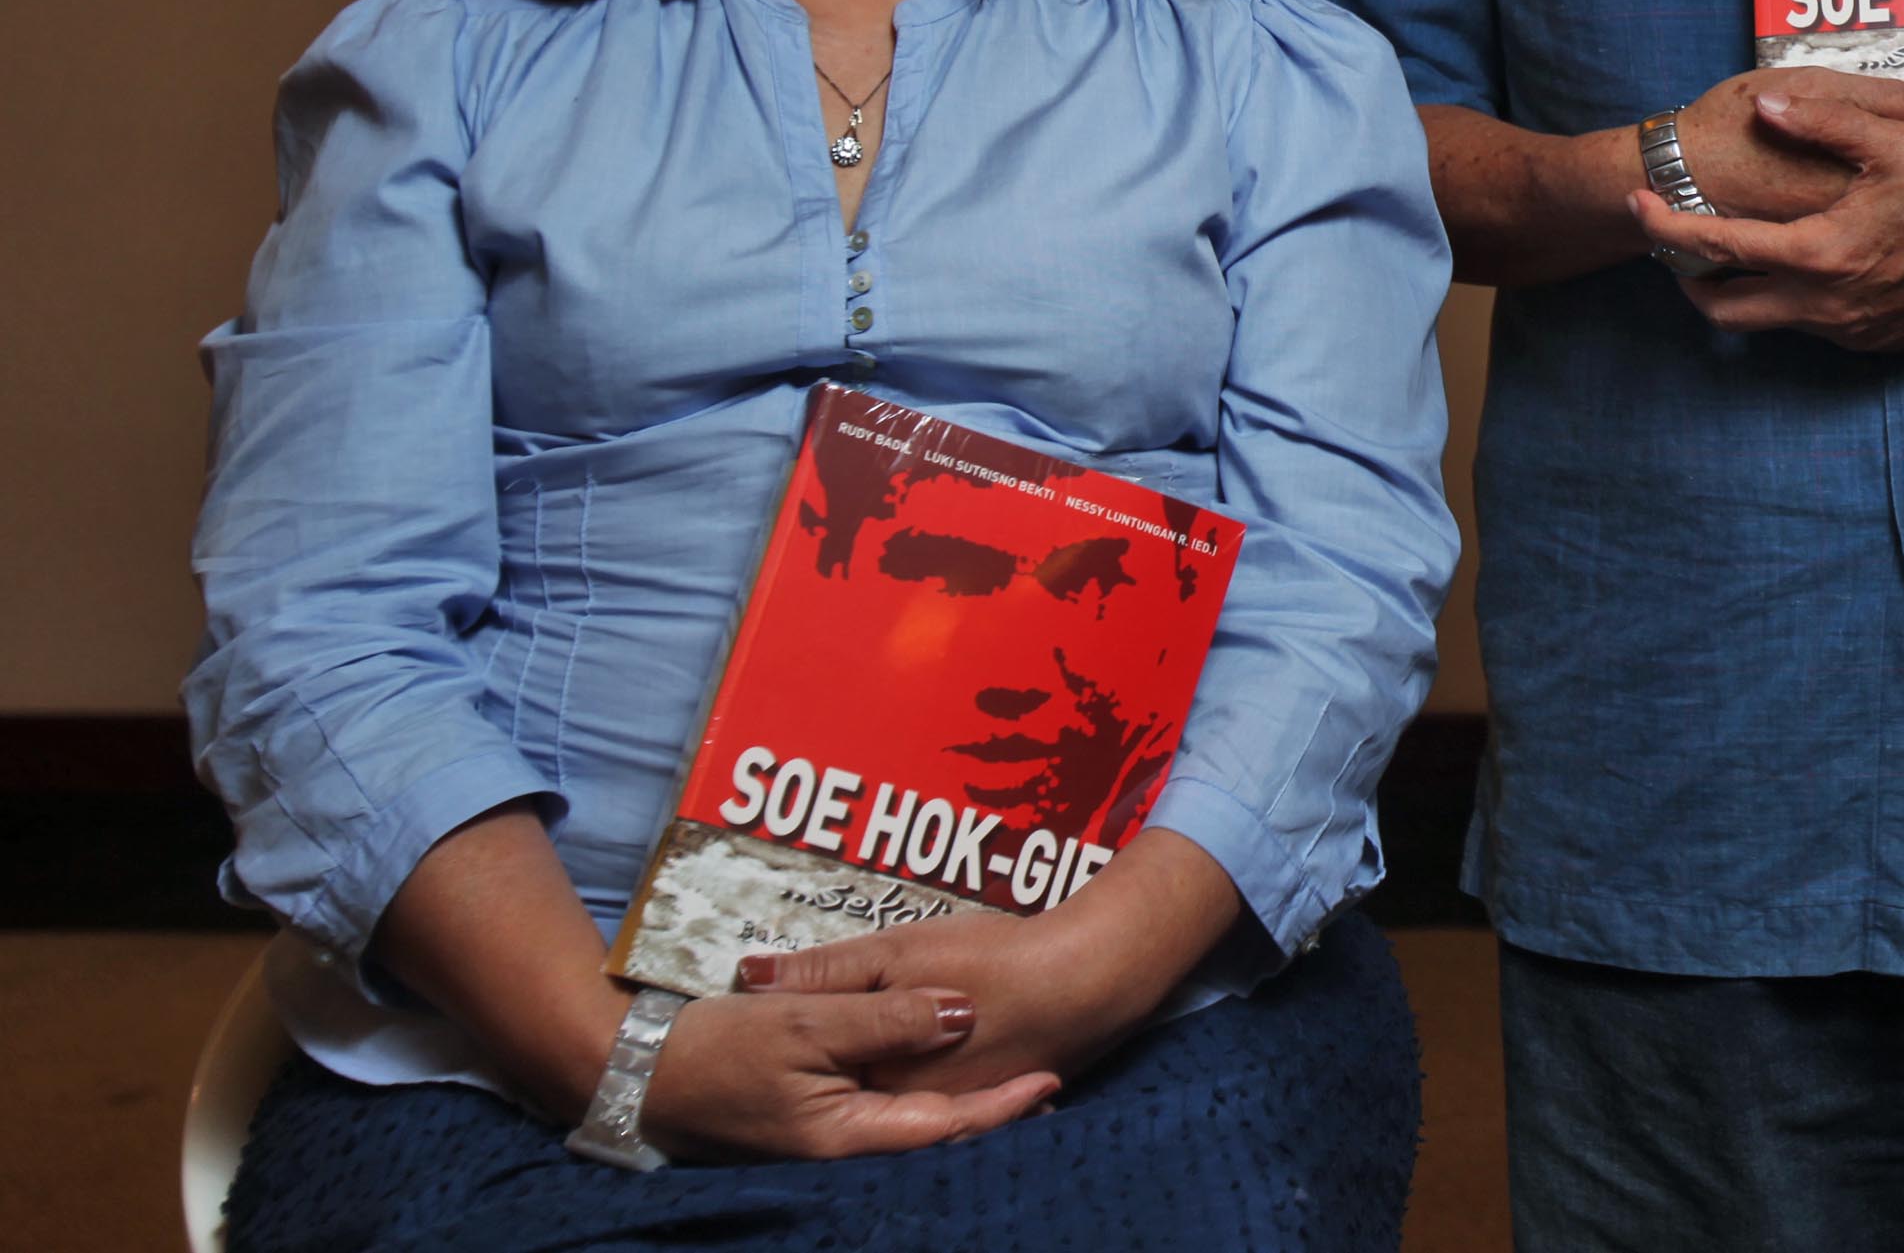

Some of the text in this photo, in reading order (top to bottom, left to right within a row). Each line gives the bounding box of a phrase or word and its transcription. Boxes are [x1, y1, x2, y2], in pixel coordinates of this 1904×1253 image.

[837, 421, 873, 442] RUDY
[874, 433, 912, 455] BADIL
[923, 449, 954, 469] LUKI
[955, 459, 1017, 489] SUTRISNO
[1018, 479, 1055, 501] BEKTI
[1065, 496, 1105, 517] NESSY
[1106, 509, 1177, 543] LUNTUNGAN
[1177, 534, 1189, 547] R.
[719, 746, 1114, 911] SOE HOK-GIE
